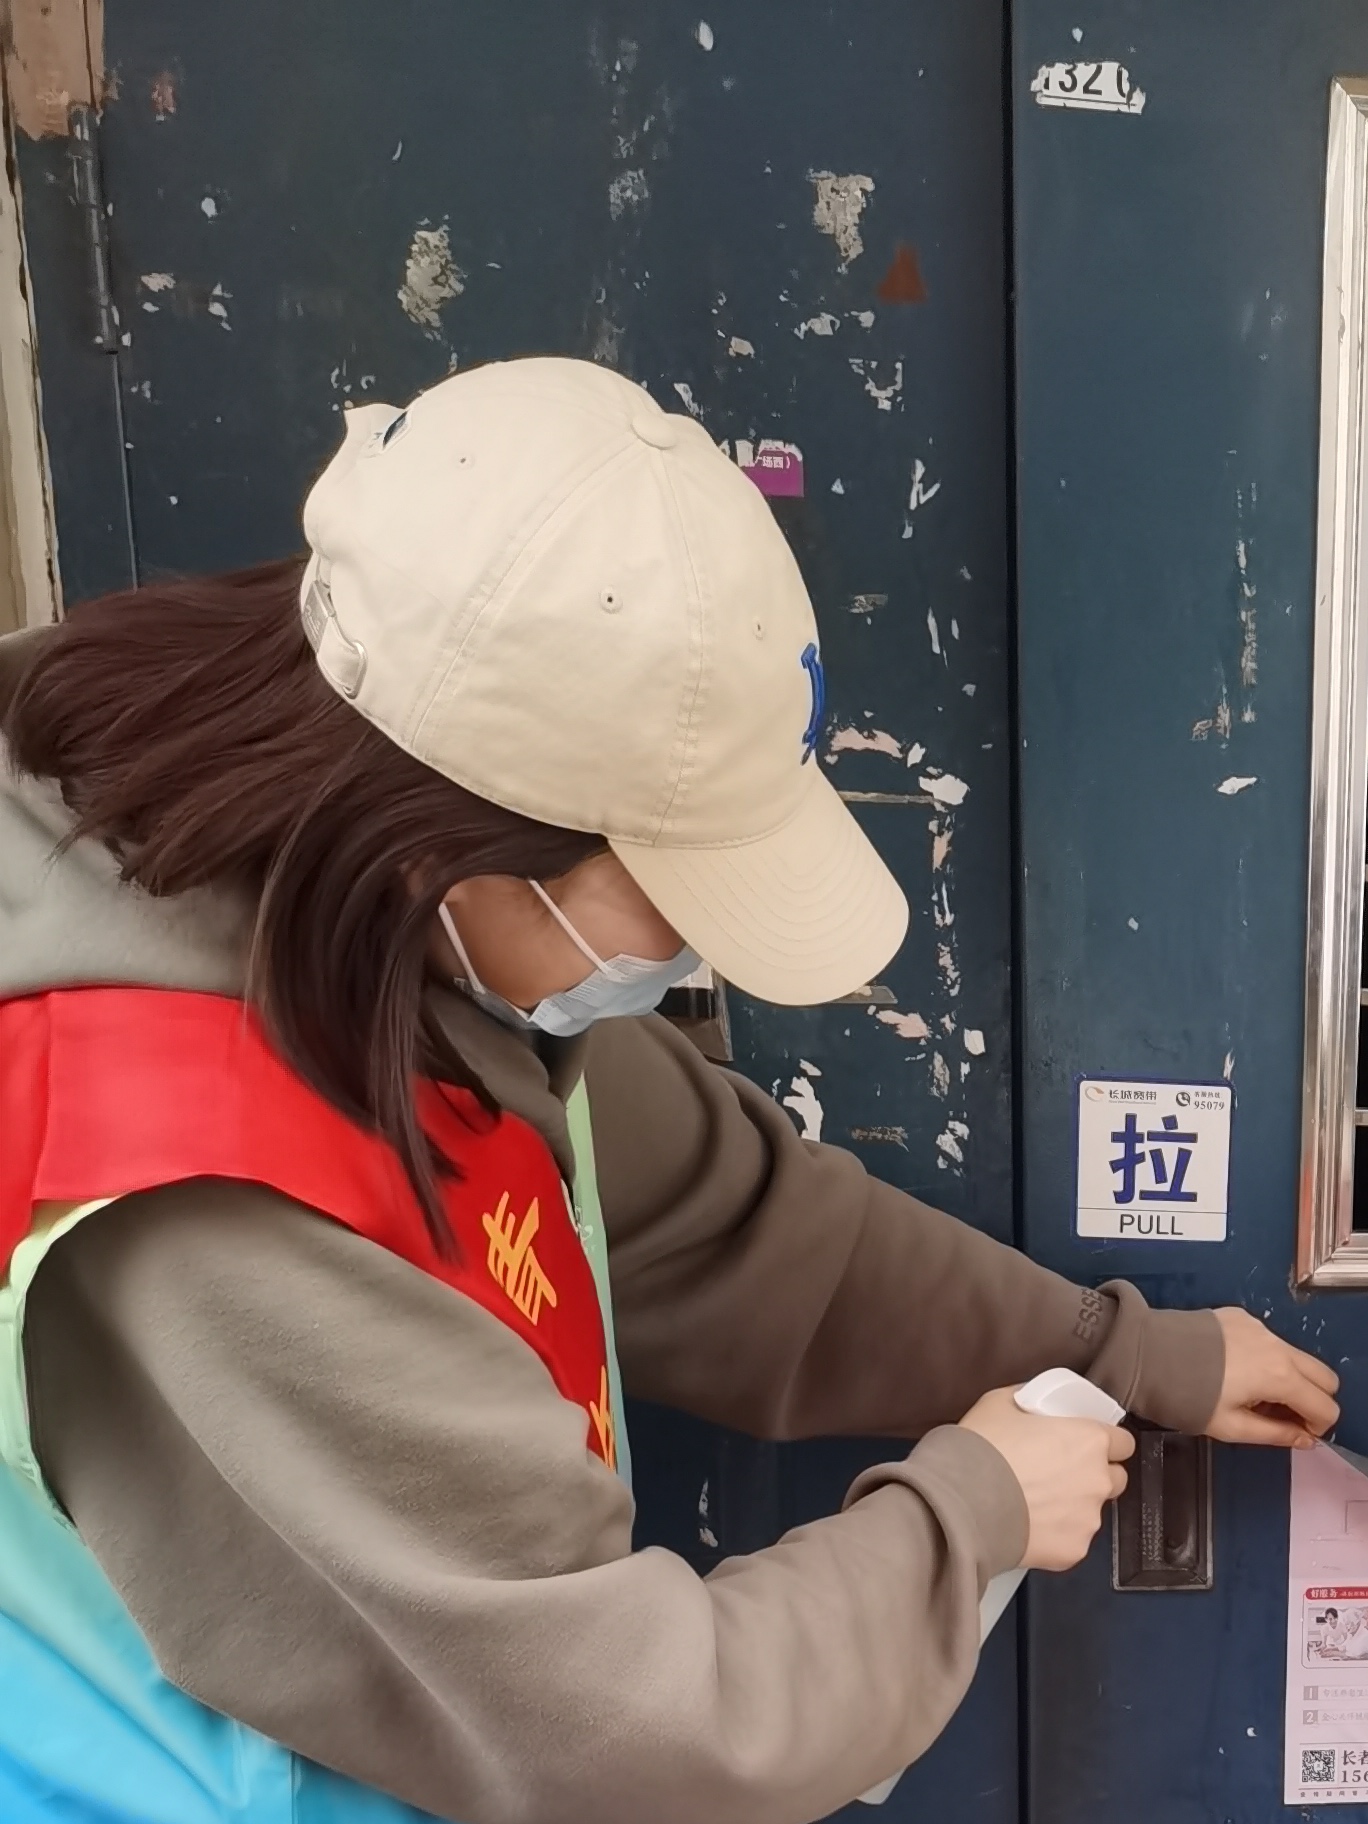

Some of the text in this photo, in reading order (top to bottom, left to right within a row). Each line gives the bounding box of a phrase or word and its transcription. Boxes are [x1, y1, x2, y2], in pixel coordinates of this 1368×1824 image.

[1193, 1101, 1225, 1111] 95079
[1109, 1113, 1198, 1204] 拉
[1120, 1214, 1184, 1236] PULL
